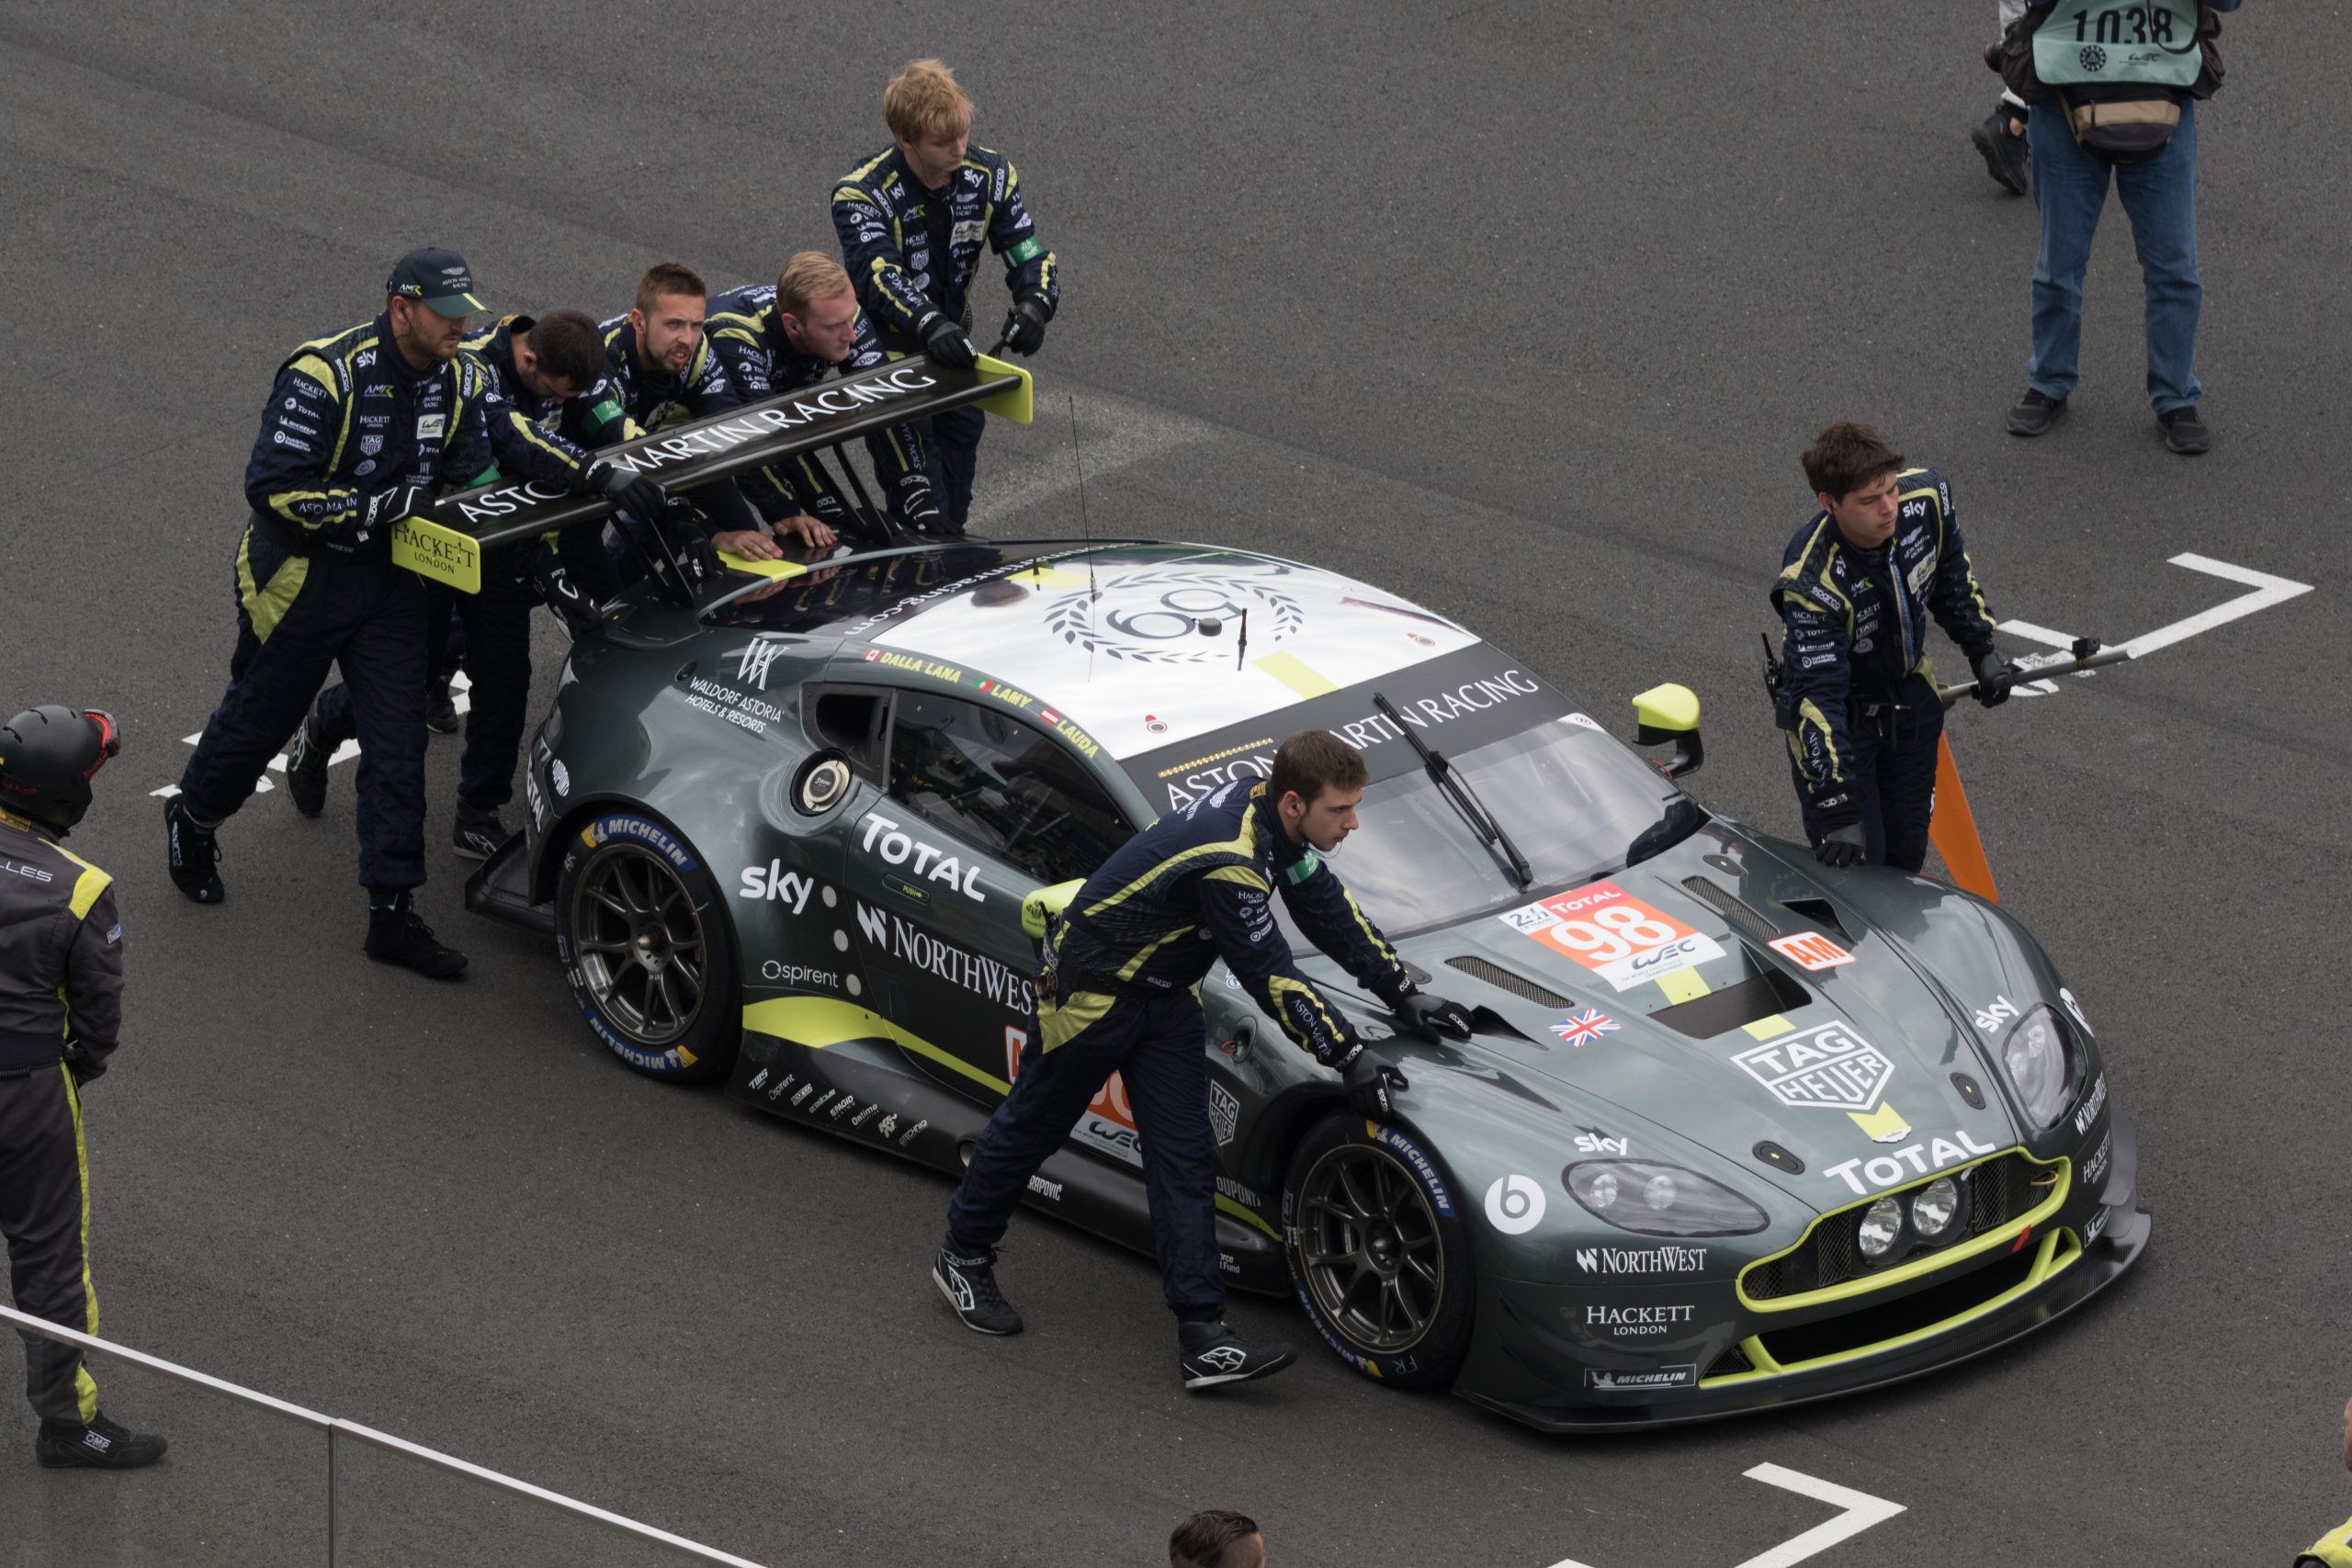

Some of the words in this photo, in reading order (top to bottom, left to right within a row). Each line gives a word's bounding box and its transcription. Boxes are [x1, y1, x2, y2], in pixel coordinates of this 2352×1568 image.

[2073, 7, 2173, 44] 1038
[965, 169, 984, 188] sky
[994, 168, 1005, 202] sparco
[847, 201, 883, 218] HACKETT
[873, 188, 894, 220] sparco
[912, 251, 928, 261] TAG
[356, 350, 377, 368] sky
[293, 378, 328, 399] HACKETT
[334, 357, 350, 394] sparco
[463, 363, 472, 398] sparco
[364, 384, 395, 399] AMR
[298, 404, 322, 420] TOTAL
[359, 415, 391, 424] HACKETT
[288, 420, 318, 435] MICHELIN
[365, 435, 382, 444] TAG
[458, 479, 570, 524] ASTO
[610, 411, 771, 474] MARTIN
[763, 367, 937, 429] RACING
[1903, 501, 1927, 518] sky
[1939, 481, 1950, 516] sparco
[393, 522, 475, 569] HACKETT
[414, 551, 455, 574] LONDON
[1811, 586, 1841, 611] sparco
[880, 651, 922, 674] DALLA
[924, 661, 961, 683] LANA
[689, 676, 741, 705] WALDORF
[738, 696, 783, 724] ASTORIA
[990, 682, 1034, 709] LAMY
[1416, 670, 1539, 724] RACING
[684, 694, 721, 715] HOTELS
[718, 706, 728, 718] &
[726, 709, 766, 734] RESORTS
[1056, 719, 1101, 759] LAUDA
[607, 818, 687, 867] MICHELIN
[862, 812, 986, 903] TOTAL
[740, 858, 814, 915] sky
[902, 884, 917, 897] PUSH
[1549, 890, 1622, 914] TOTAL
[1509, 908, 1550, 928] 24h
[1550, 906, 1677, 962] 98
[1631, 939, 1696, 970] WEC
[1783, 933, 1843, 967] AM
[781, 963, 839, 989] spirent
[893, 916, 1033, 1016] NORTHWES
[1294, 998, 1317, 1029] ASTON
[1449, 1013, 1469, 1032] sparco
[1975, 994, 2020, 1033] sky
[589, 1016, 666, 1071] MICHELIN
[1748, 1029, 1851, 1076] TAG
[1778, 1052, 1885, 1103] HEUER
[833, 1095, 854, 1114] PAGID
[1213, 1087, 1236, 1121] TAG
[1378, 1088, 1388, 1112] sparco
[852, 1103, 878, 1126] Ontime
[1210, 1104, 1235, 1145] HEUER
[1573, 1133, 1628, 1156] sky
[2083, 1129, 2110, 1183] HACKETT
[1389, 1134, 1451, 1210] MICHELIN
[1823, 1130, 1996, 1196] TOTAL
[2092, 1158, 2108, 1184] LONDON
[1224, 1262, 1240, 1274] Fund
[1601, 1246, 1707, 1274] NORTHWEST
[1586, 1304, 1695, 1325] HACKETT
[1613, 1325, 1668, 1336] LONDON
[1391, 1354, 1419, 1375] FR
[1616, 1371, 1686, 1384] MICHELIN
[85, 1433, 109, 1450] OMP
